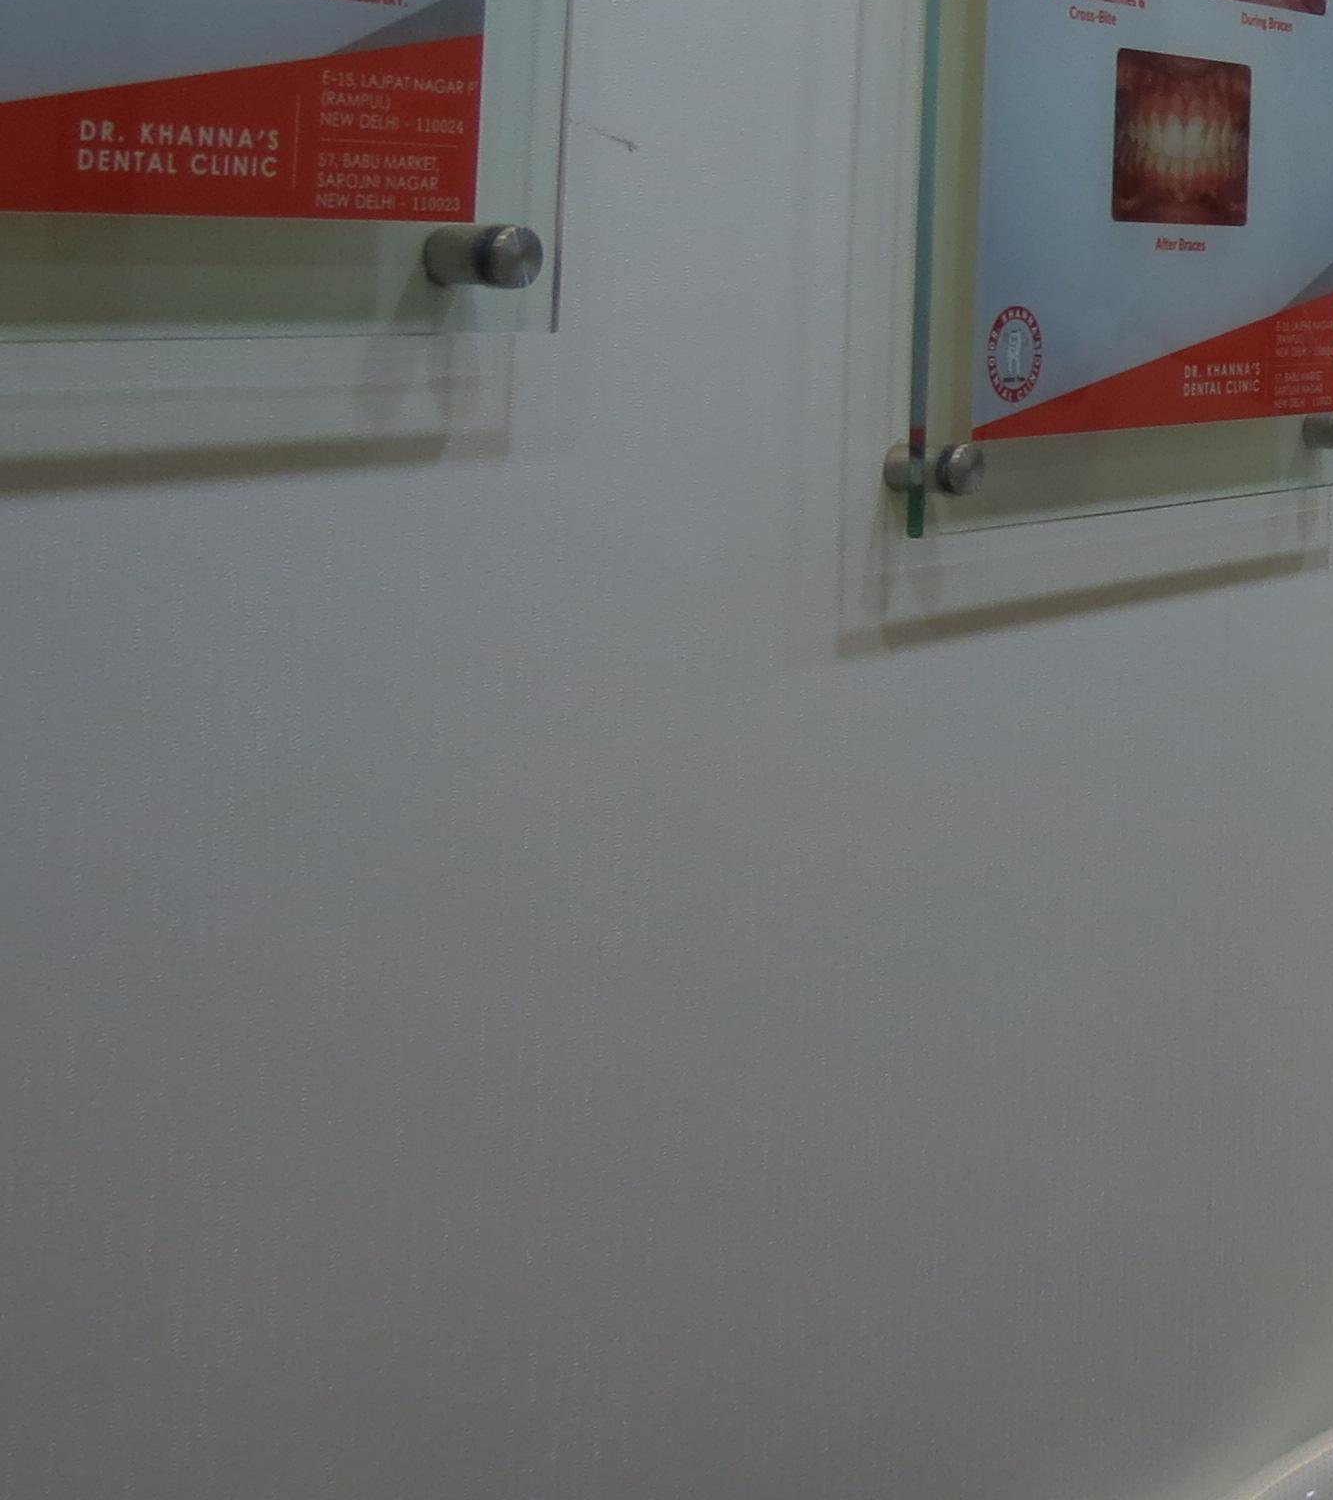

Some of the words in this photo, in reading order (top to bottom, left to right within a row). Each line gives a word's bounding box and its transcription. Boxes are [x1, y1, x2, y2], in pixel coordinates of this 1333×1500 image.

[414, 78, 465, 95] NAGAR
[320, 112, 353, 127] NEW
[359, 113, 399, 131] DELHI
[79, 120, 125, 143] DR.
[140, 122, 280, 151] KHANNA'S
[77, 149, 177, 174] DENTAL
[191, 153, 278, 178] CLINIC
[386, 174, 438, 191] NAGAR
[1183, 382, 1221, 396] DENTAL
